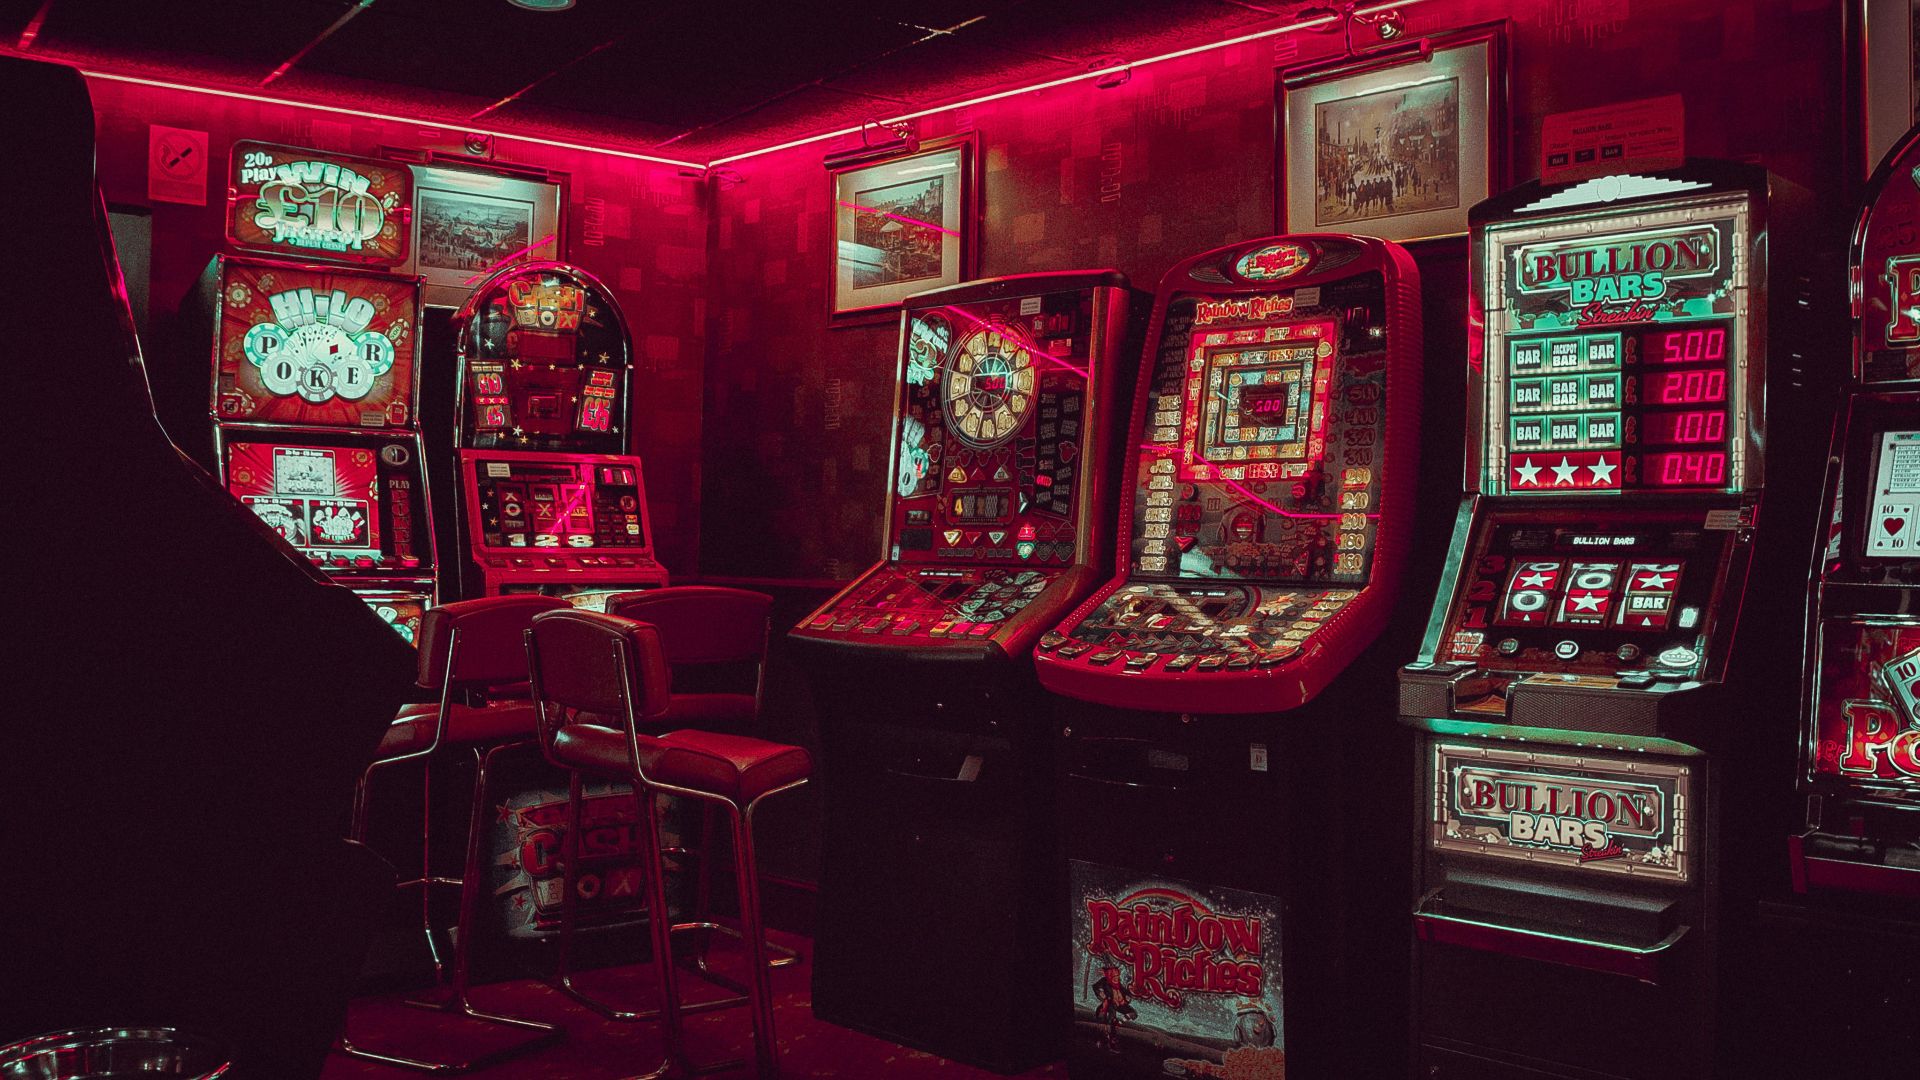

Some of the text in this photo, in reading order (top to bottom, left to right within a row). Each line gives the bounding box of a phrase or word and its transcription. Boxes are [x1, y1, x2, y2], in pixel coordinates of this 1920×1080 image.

[244, 152, 273, 168] 20p
[241, 166, 277, 184] Play
[276, 161, 371, 194] WIN
[254, 179, 385, 241] £10
[1533, 236, 1702, 283] BULLION
[1571, 270, 1666, 306] BARS
[517, 311, 580, 329] BOX
[1195, 299, 1249, 324] Rainbow
[1248, 296, 1293, 319] Riches
[1517, 344, 1615, 366] BAR BAR BAR
[1553, 343, 1577, 355] JACKPOT
[1663, 330, 1725, 363] 5.00
[1517, 383, 1615, 406] BAR BAR BAR
[1552, 381, 1577, 393] BAR
[1662, 371, 1725, 404] 2.00
[1517, 423, 1615, 440] BAR BAR BAR
[1675, 412, 1725, 442] 1.00
[1662, 454, 1725, 484] 0.40
[389, 480, 410, 489] PLAY
[1882, 505, 1894, 514] 10
[1573, 537, 1635, 546] BULLION BARS
[1892, 539, 1904, 548] 10
[1632, 597, 1665, 609] BAR
[1895, 661, 1917, 682] 10
[1472, 778, 1646, 828] BULLION
[1510, 811, 1607, 849] BARS
[1086, 898, 1262, 965] Rainbow
[1128, 942, 1264, 1010] Riches
